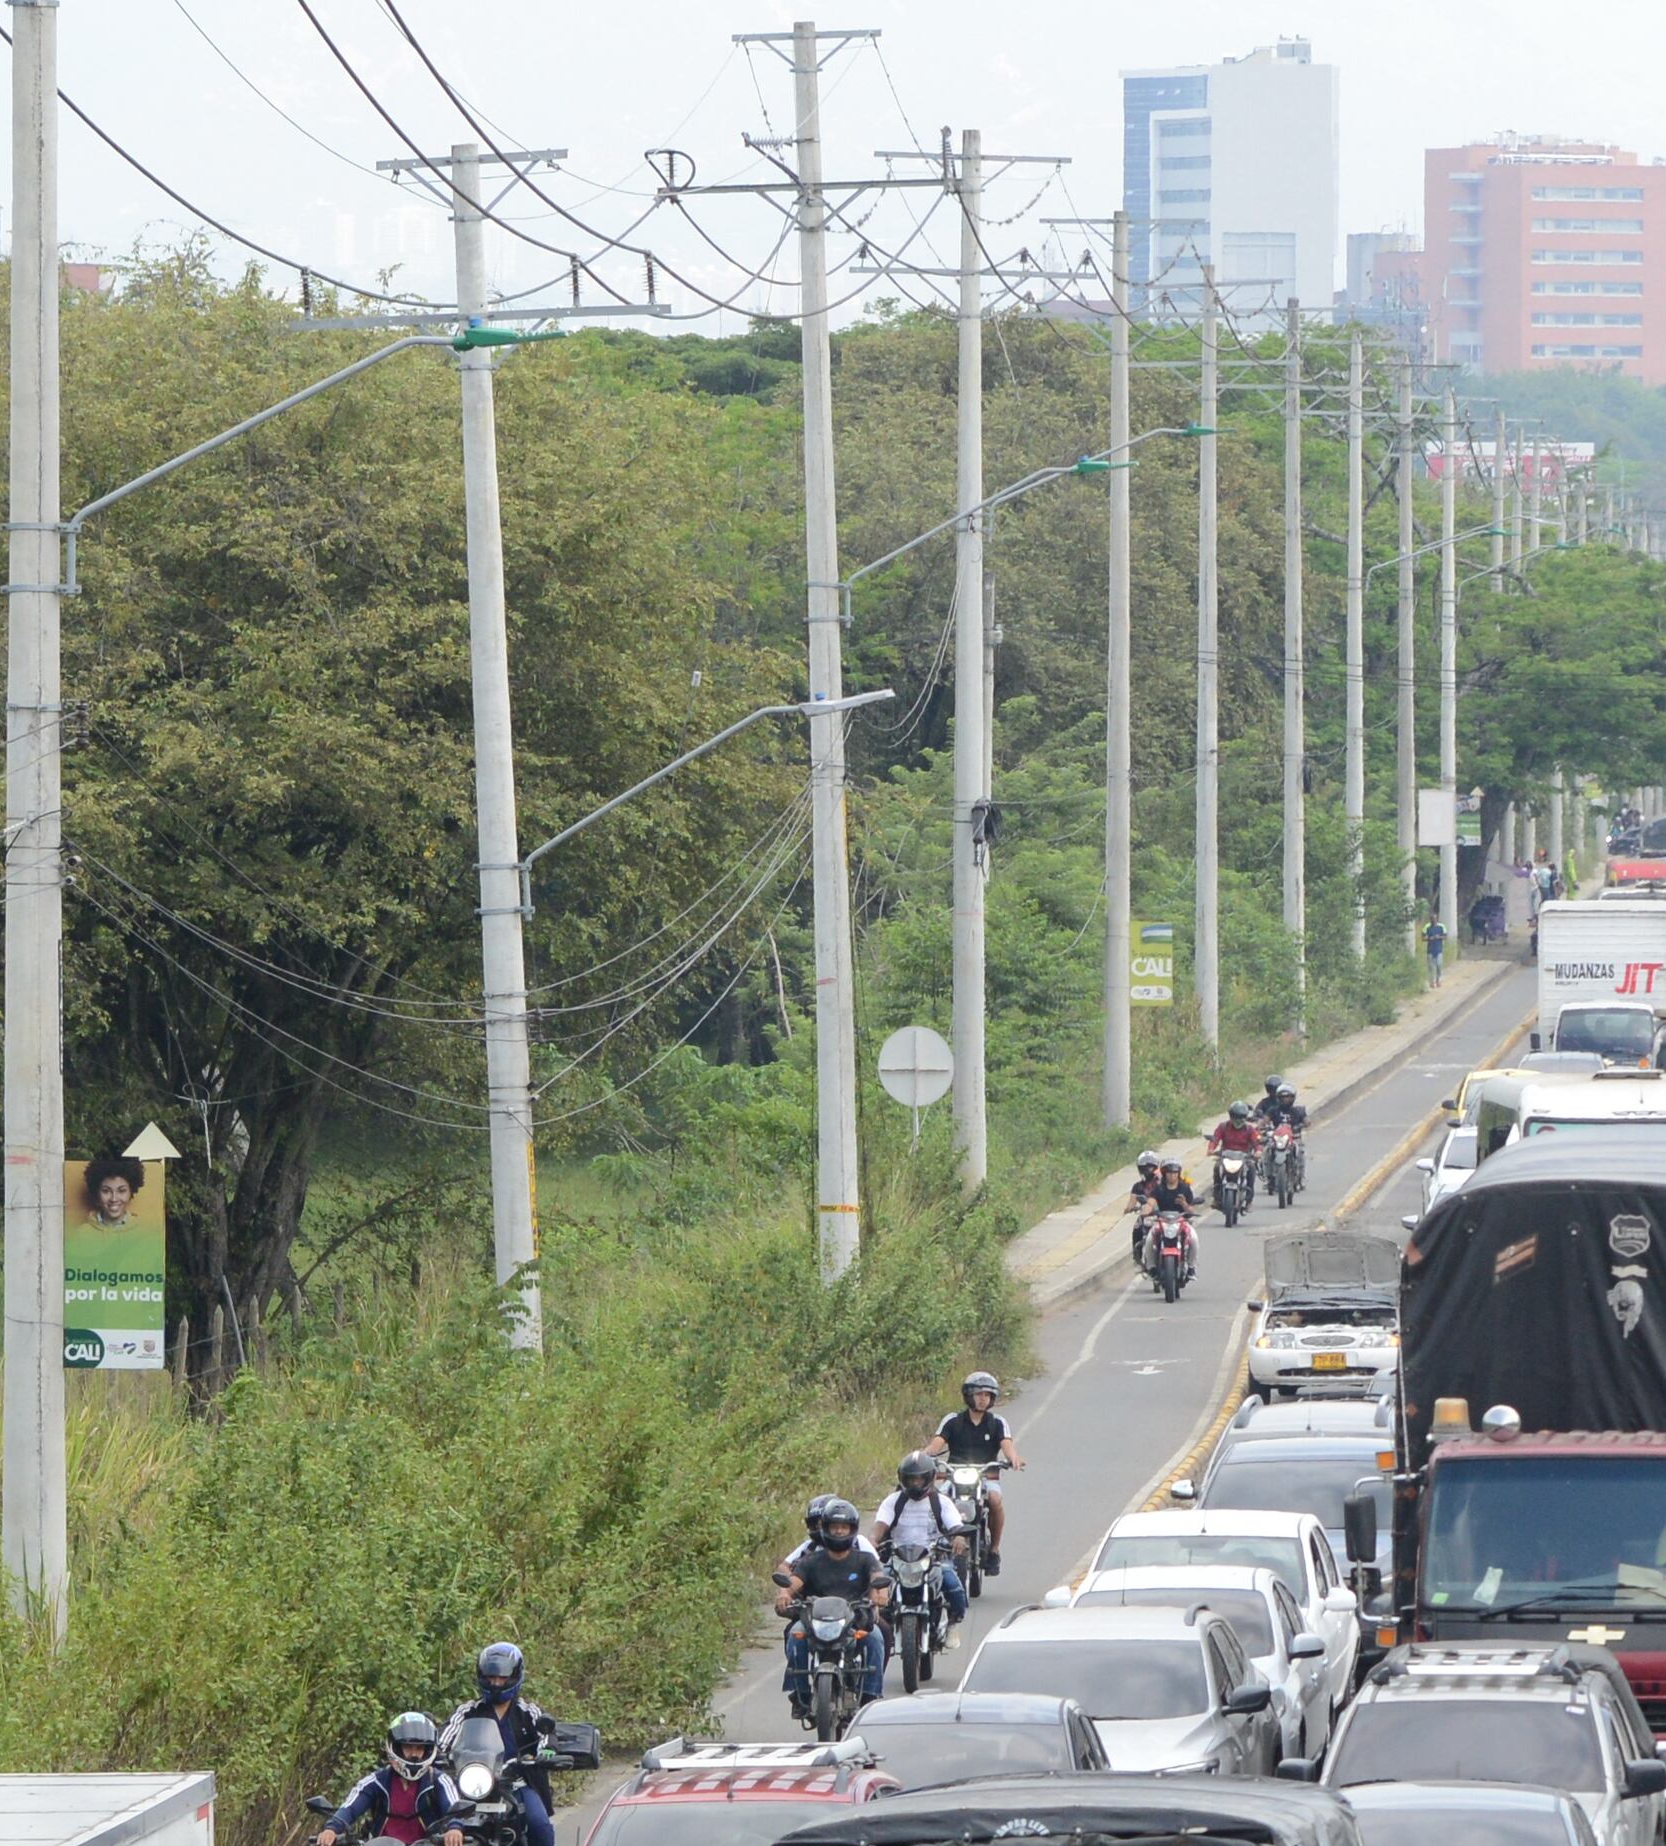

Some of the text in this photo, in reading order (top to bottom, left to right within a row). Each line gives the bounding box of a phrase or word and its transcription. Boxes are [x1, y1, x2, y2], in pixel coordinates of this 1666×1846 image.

[1555, 962, 1664, 994] MUDANZAS JIT
[64, 1268, 163, 1286] Dialogamos
[65, 1286, 163, 1304] por la vida
[64, 1343, 101, 1361] CALI
